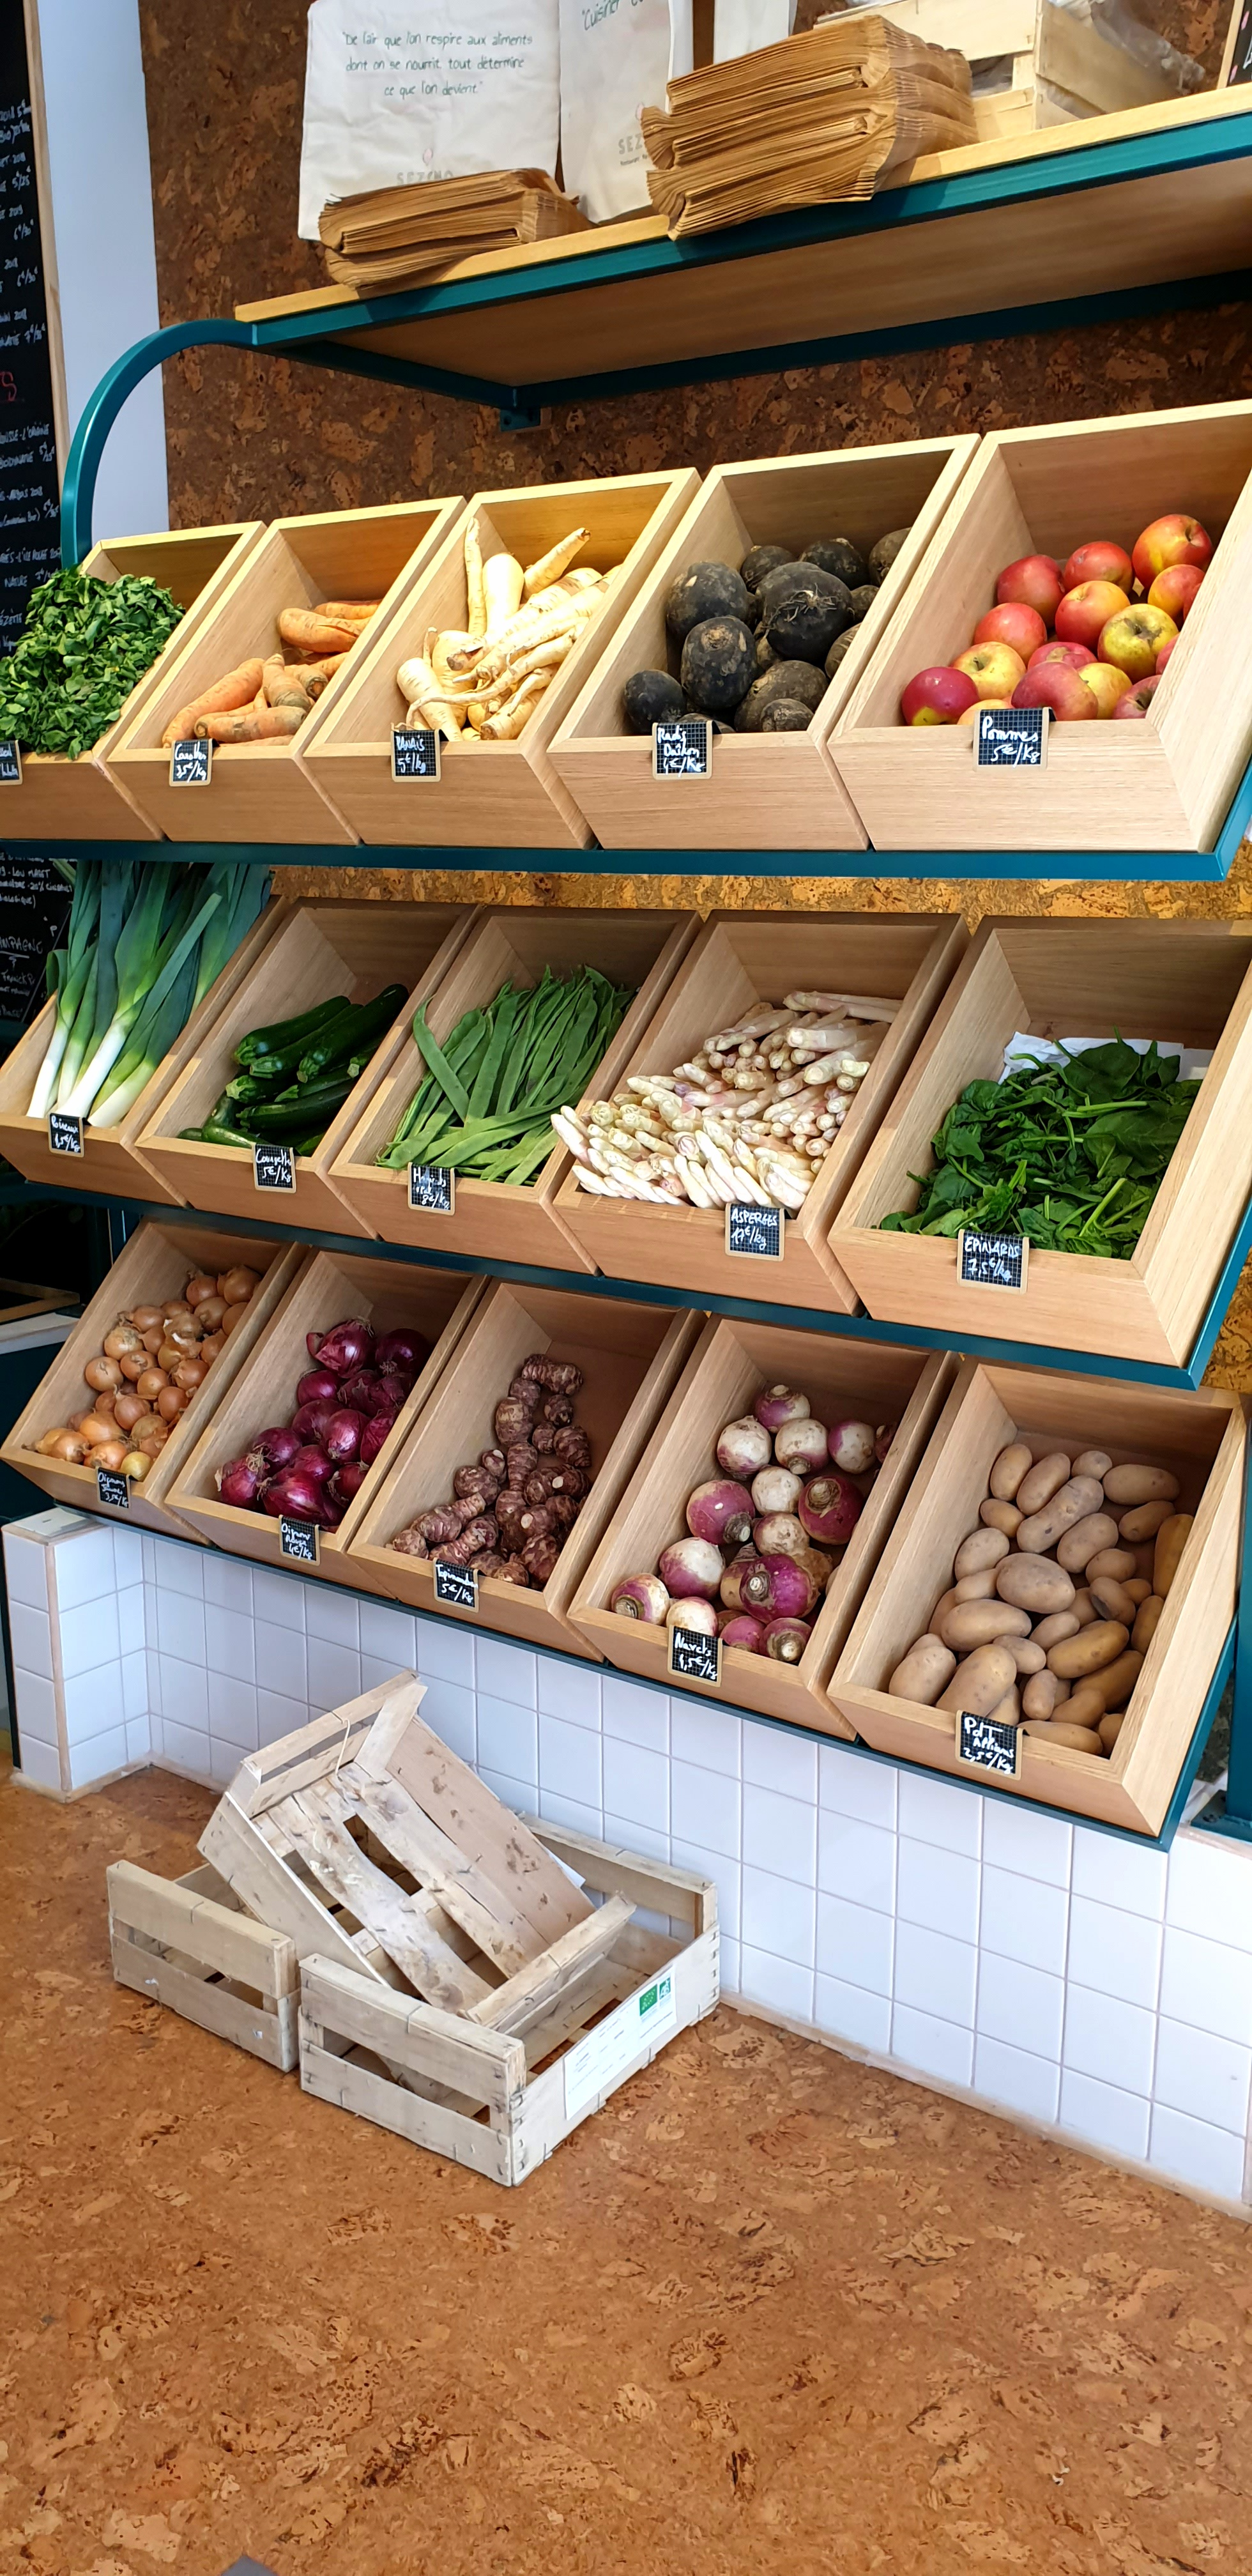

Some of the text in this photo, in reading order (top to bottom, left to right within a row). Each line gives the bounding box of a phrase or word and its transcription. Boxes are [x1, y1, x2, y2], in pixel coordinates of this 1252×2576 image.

[384, 37, 402, 49] que
[426, 33, 462, 50] respire
[467, 36, 486, 45] aux
[492, 31, 533, 46] aliments
[346, 57, 368, 71] dont
[373, 60, 385, 70] on
[390, 61, 401, 70] se
[449, 57, 472, 70] tout
[477, 56, 525, 70] détermine
[384, 87, 393, 96] ce
[400, 86, 416, 100] que
[982, 716, 1039, 742] Pommes
[731, 1208, 777, 1227] ASPERGES
